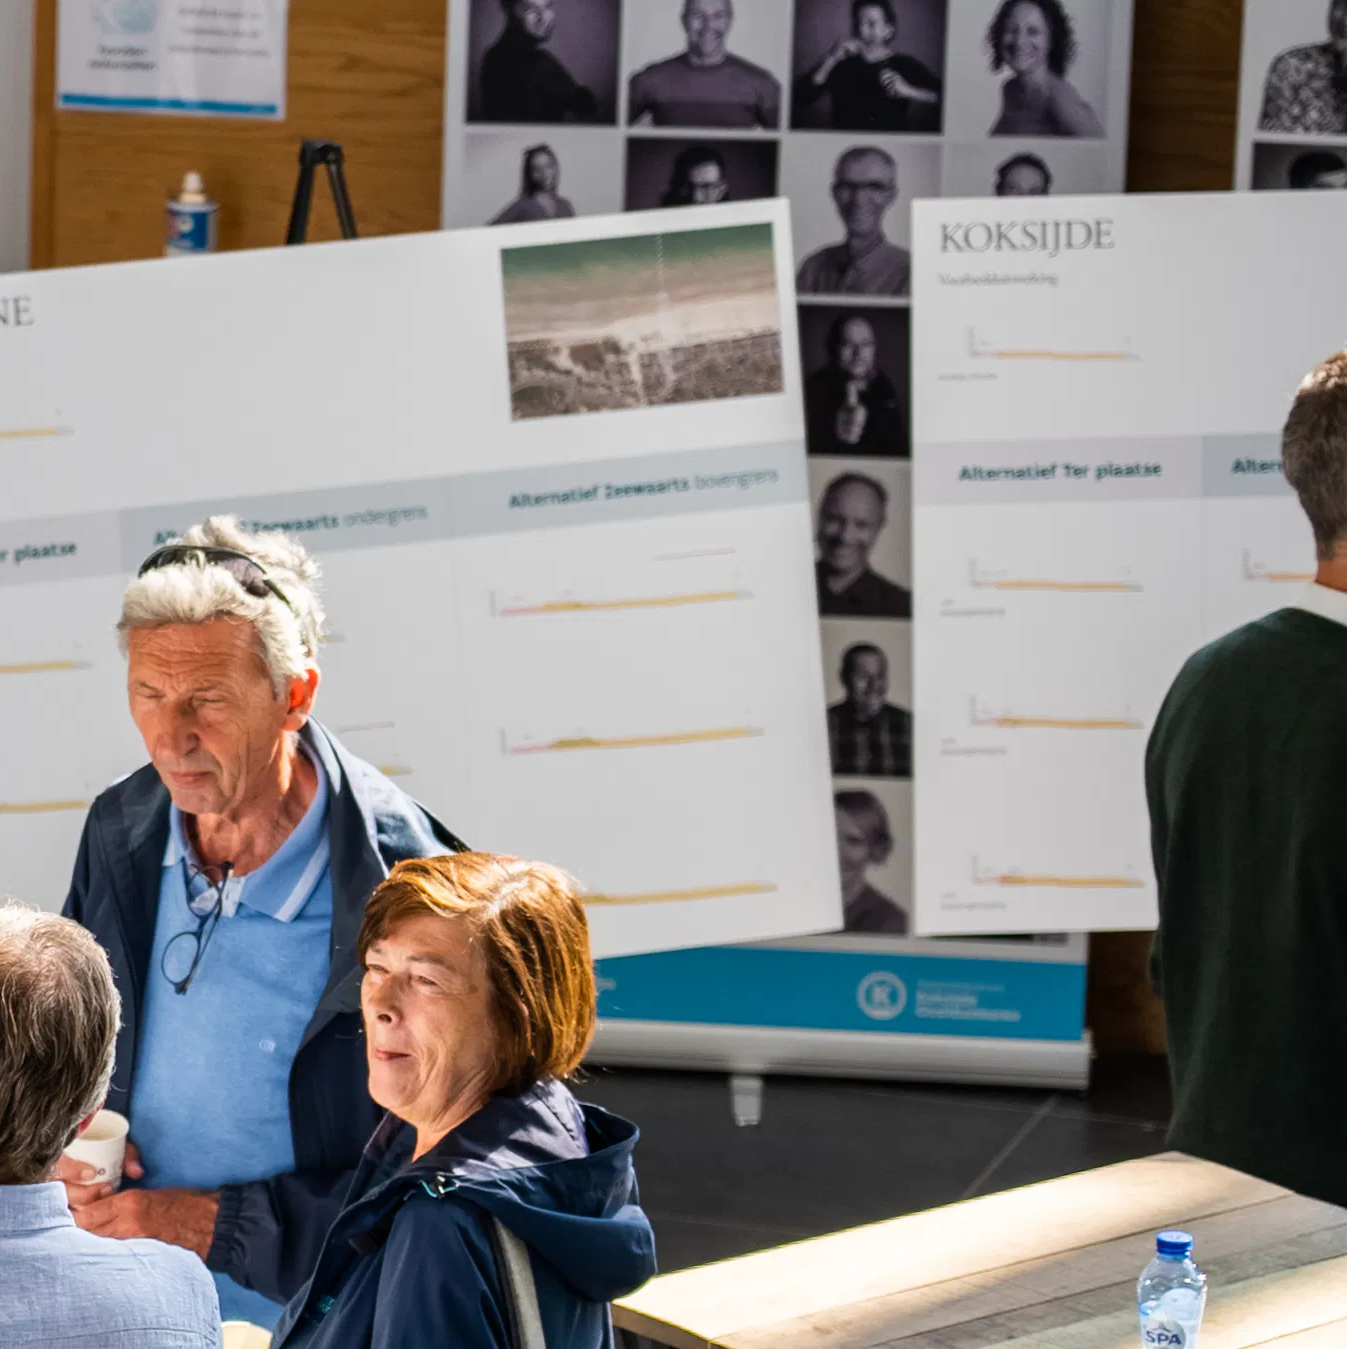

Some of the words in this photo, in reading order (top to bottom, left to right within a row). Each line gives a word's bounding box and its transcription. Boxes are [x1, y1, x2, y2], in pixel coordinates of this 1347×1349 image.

[939, 218, 1116, 258] KOKSIJDE
[958, 463, 1058, 482] Alternatief
[1063, 462, 1091, 481] Ter
[1095, 462, 1163, 483] plaatse
[508, 485, 600, 510] Alternatief
[13, 540, 78, 564] plaatse
[1145, 1329, 1183, 1346] SPA
